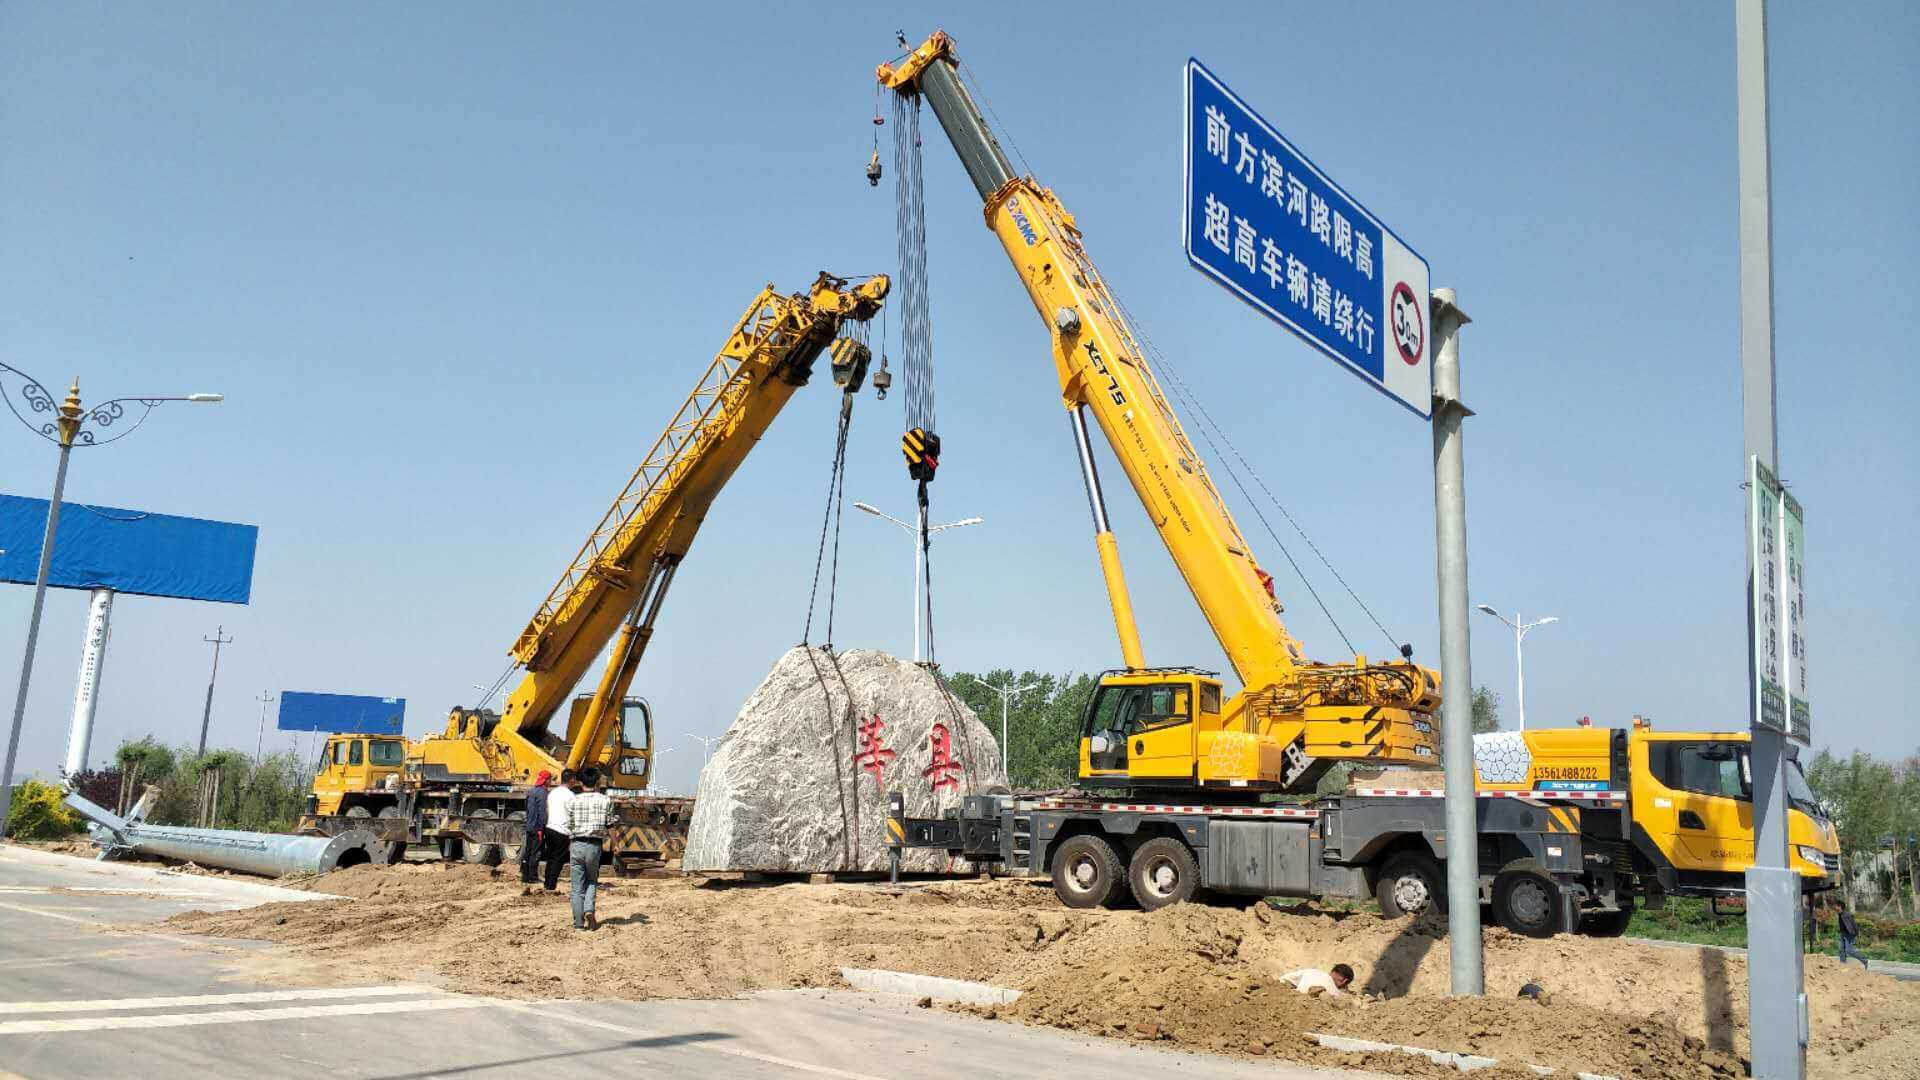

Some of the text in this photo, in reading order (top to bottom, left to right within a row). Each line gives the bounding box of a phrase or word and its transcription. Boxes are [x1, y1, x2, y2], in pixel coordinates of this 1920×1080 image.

[1204, 104, 1373, 281] 前方滨河路限高
[1204, 192, 1375, 355] 超高车辆请绕行
[1083, 339, 1127, 406] XCT75
[1533, 767, 1599, 780] 13561488222
